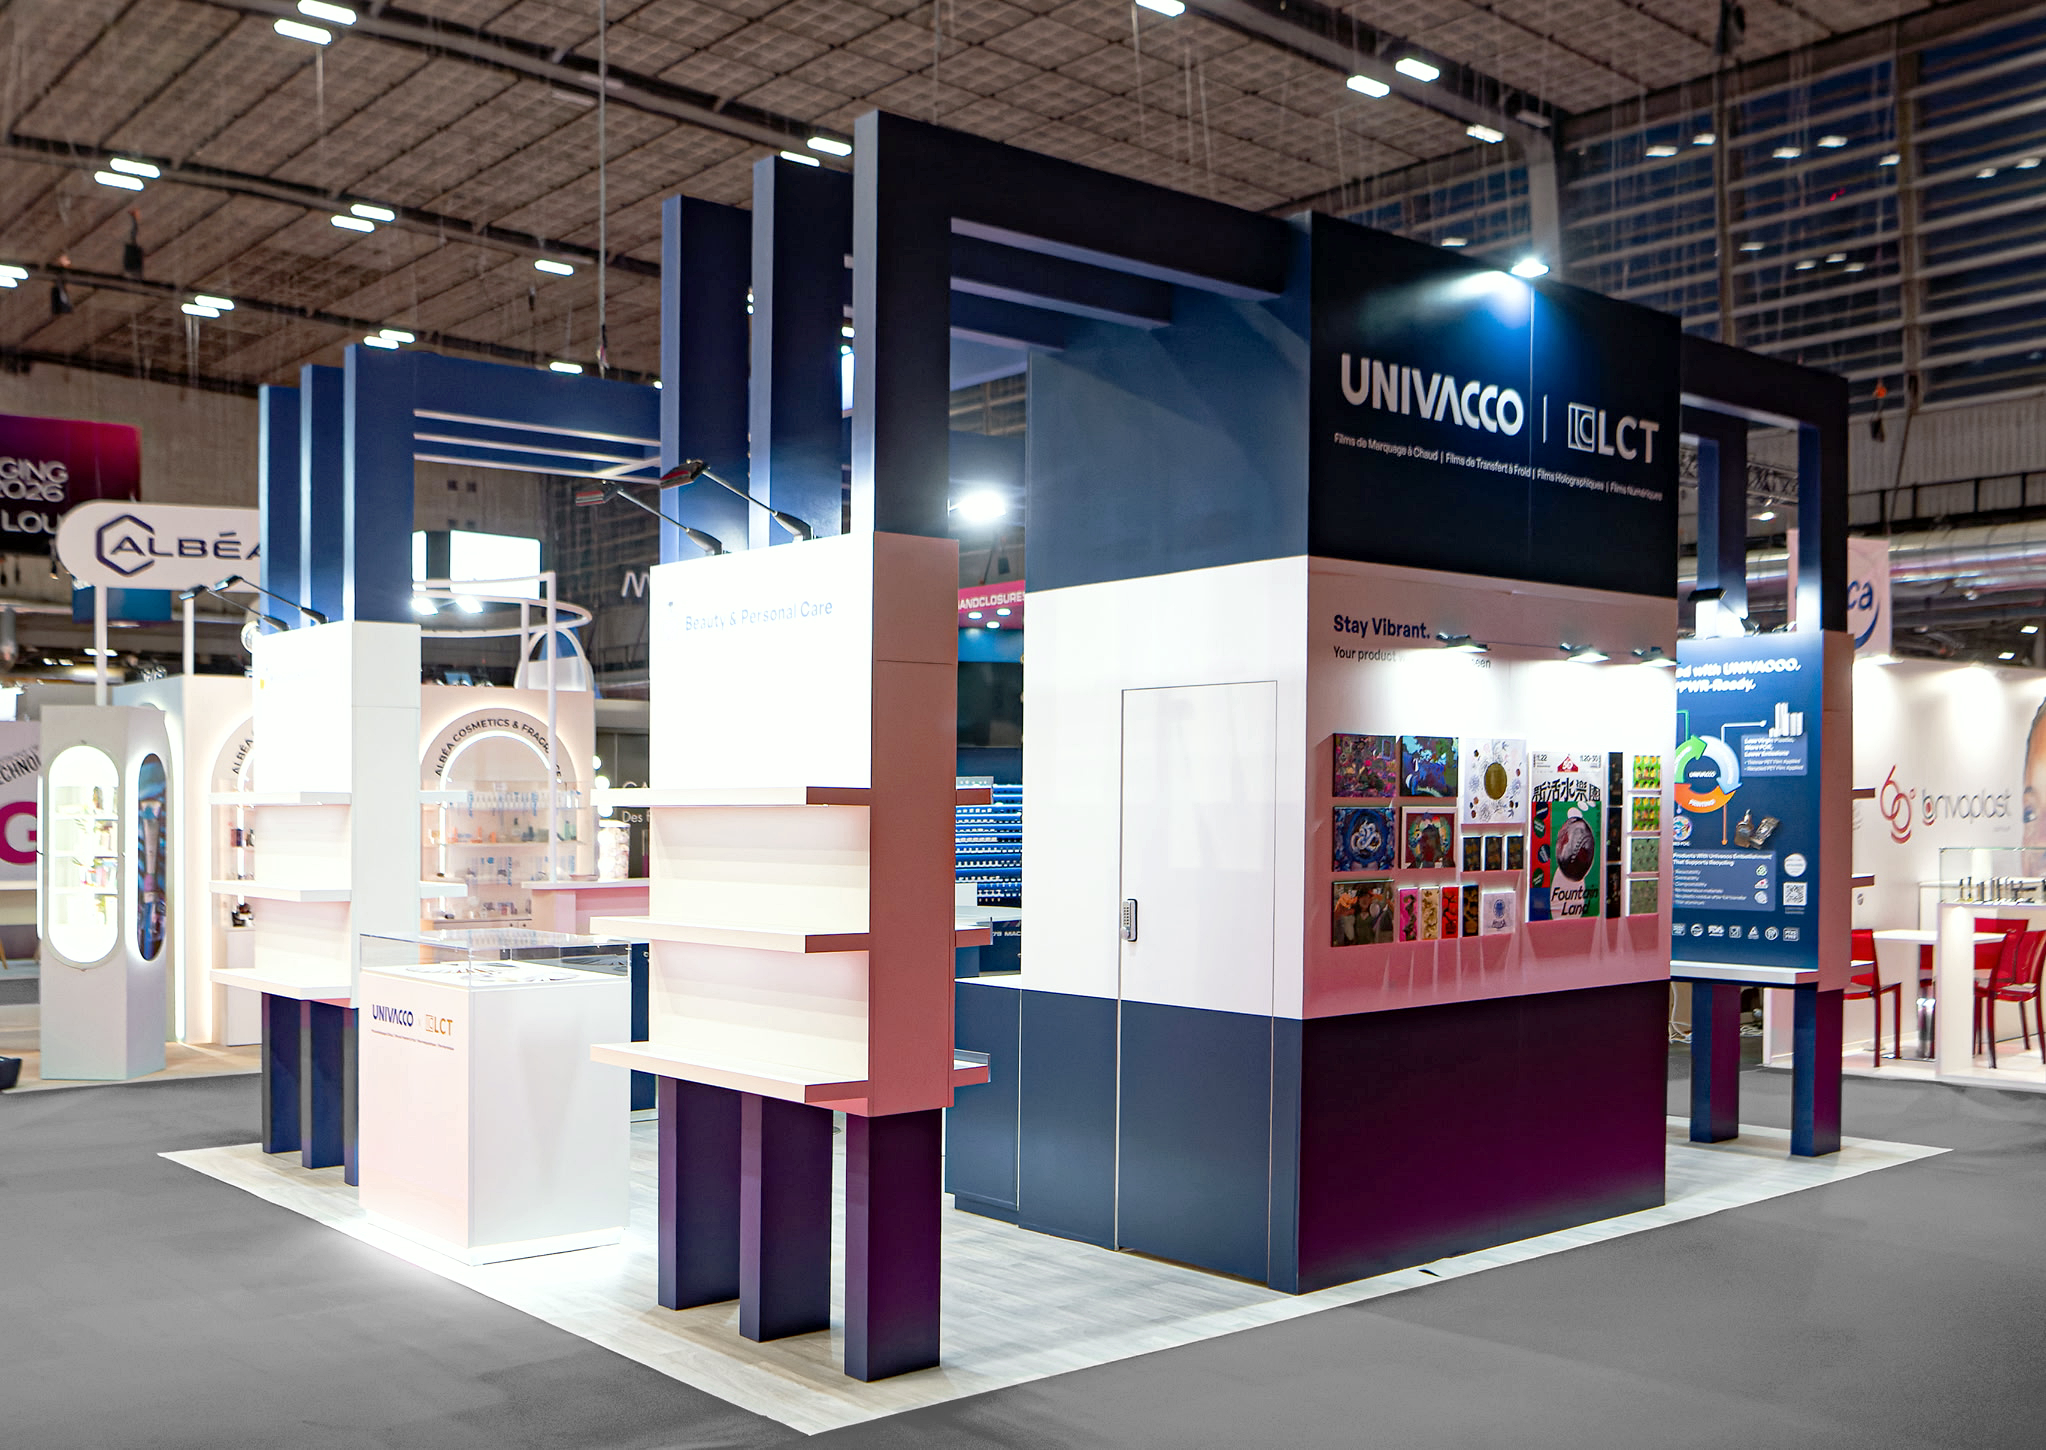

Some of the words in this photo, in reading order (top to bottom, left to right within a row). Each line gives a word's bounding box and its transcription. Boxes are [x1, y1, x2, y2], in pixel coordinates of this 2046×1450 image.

[1341, 353, 1524, 436] UNIVACCO
[1598, 410, 1660, 464] LCT
[1334, 432, 1355, 447] Films
[1356, 437, 1367, 448] de
[1368, 438, 1407, 456] Marquage
[1413, 446, 1438, 461] Chaud
[1445, 452, 1465, 466] Films
[1465, 457, 1475, 468] de
[1476, 457, 1508, 473] Transfert
[1513, 465, 1531, 477] Froid
[958, 590, 1024, 610] ANDCLOSURE
[685, 615, 725, 631] Beauty
[729, 611, 737, 626] &
[741, 602, 797, 624] Personal
[800, 600, 833, 617] Care
[1333, 614, 1368, 638] Stay
[1372, 617, 1431, 639] Vibrant.
[1333, 646, 1356, 659] Your
[1357, 648, 1396, 662] product
[453, 718, 510, 742] COSMETICS
[622, 810, 643, 823] Des
[1551, 885, 1599, 901] Fountain
[1561, 901, 1591, 916] Land
[372, 1004, 414, 1027] UNIVACCO
[434, 1015, 453, 1036] LCT
